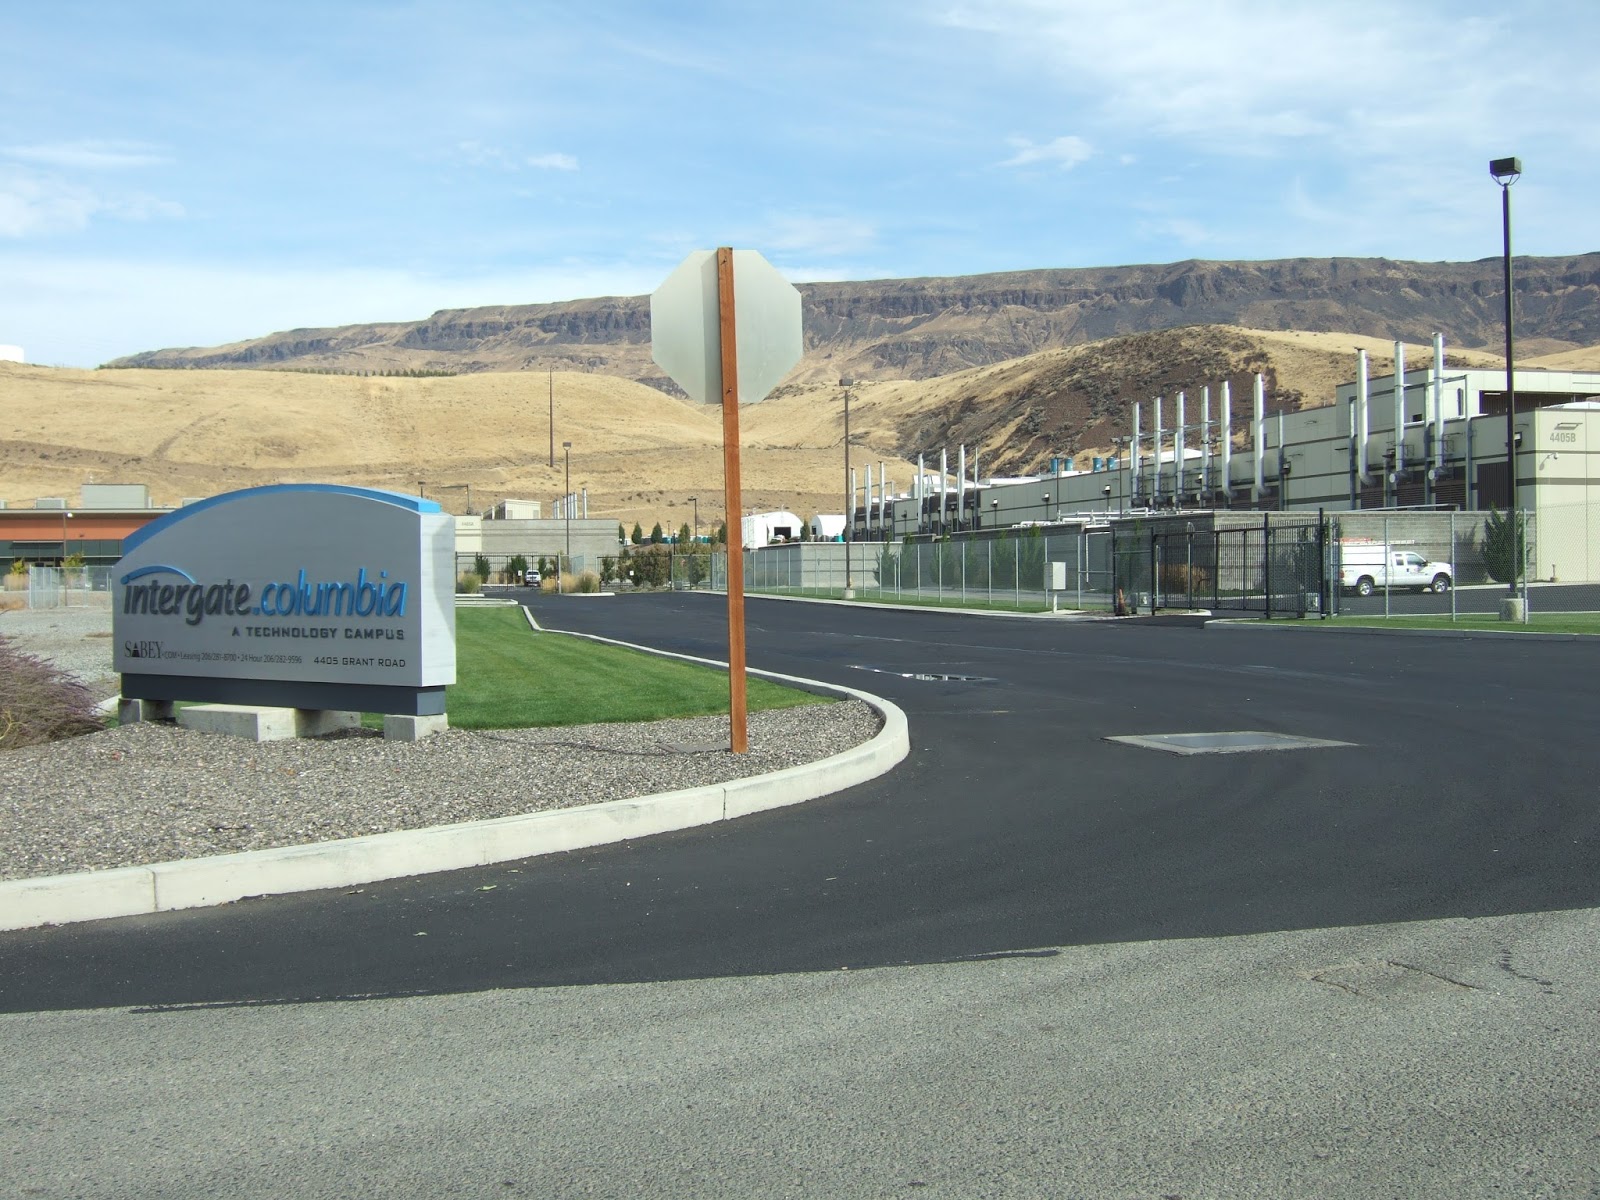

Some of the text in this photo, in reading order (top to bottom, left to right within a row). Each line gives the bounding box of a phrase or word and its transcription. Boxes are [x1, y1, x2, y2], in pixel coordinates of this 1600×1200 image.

[1550, 432, 1576, 442] 4405B
[231, 626, 404, 640] A TECHNOLOGY CAMPUS
[248, 654, 263, 662] Hour
[314, 656, 406, 668] 4405 GRANT ROAD
